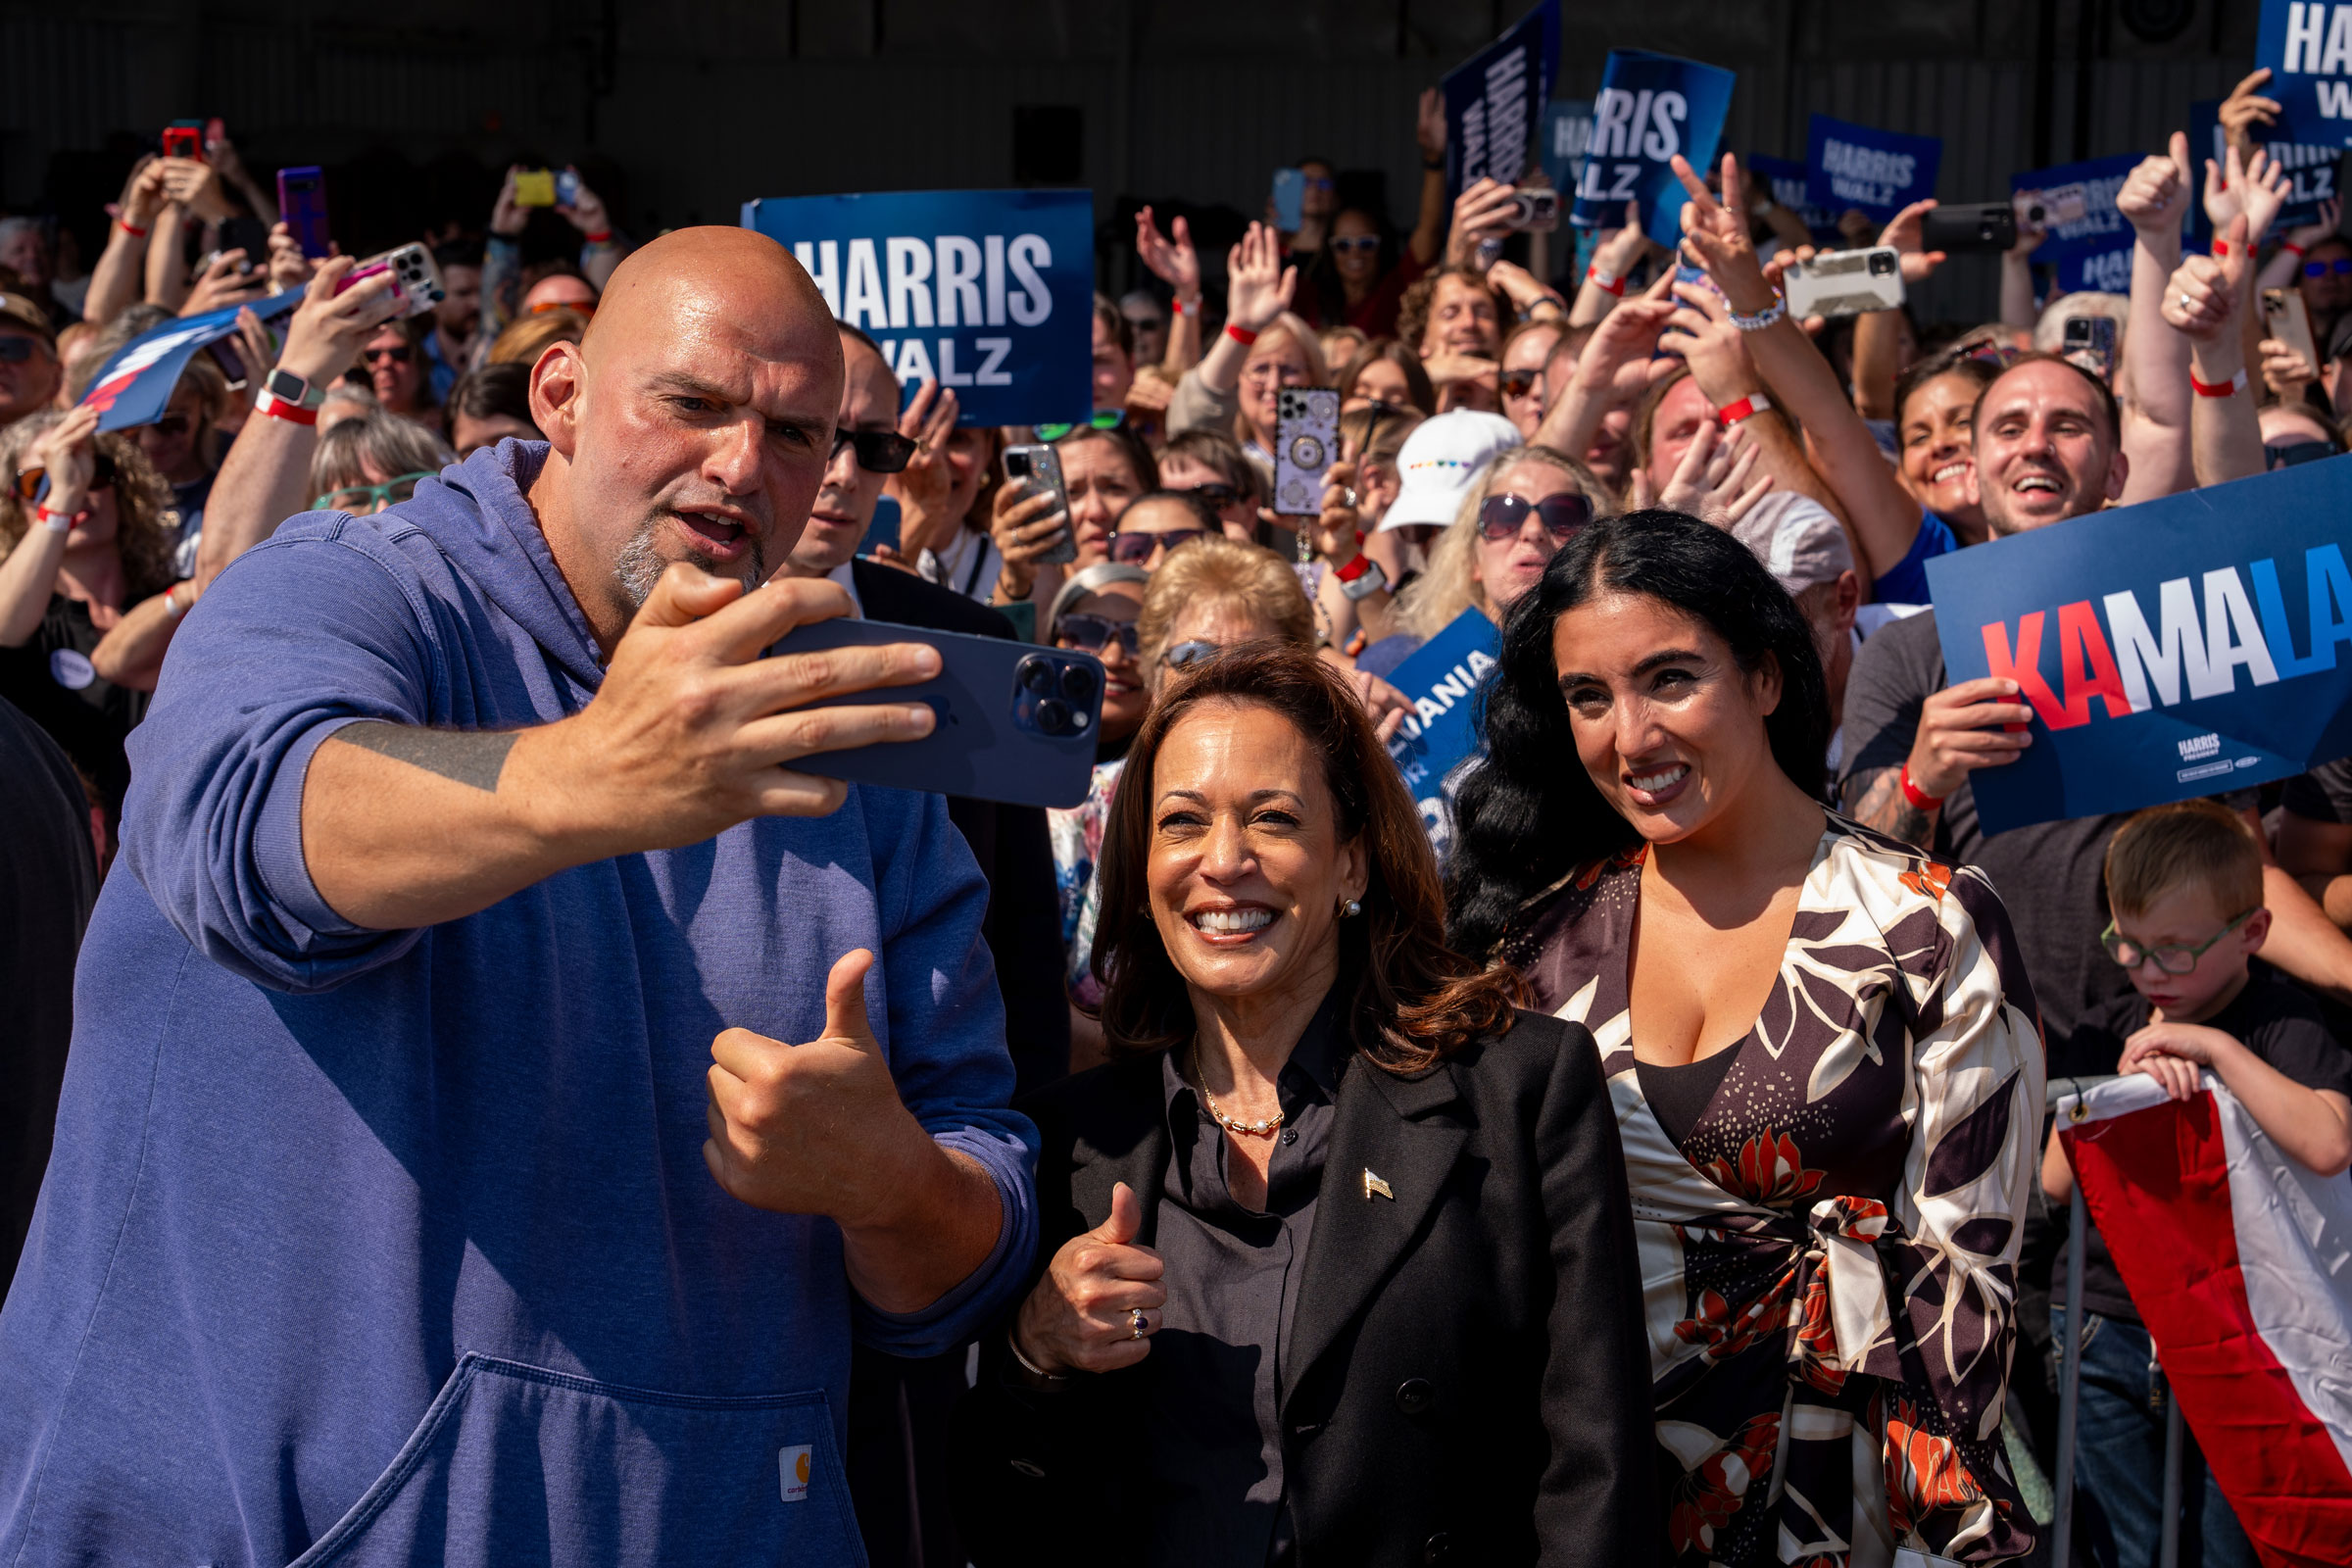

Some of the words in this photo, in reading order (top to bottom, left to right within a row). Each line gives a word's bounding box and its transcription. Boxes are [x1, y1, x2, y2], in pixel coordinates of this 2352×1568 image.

[1585, 86, 1688, 162] RIS
[1822, 137, 1916, 189] HARRIS
[1832, 176, 1894, 206] WALZ
[794, 233, 1053, 329] HARRIS
[883, 337, 1012, 386] ALZ
[1981, 543, 2352, 733] KAMALA
[2178, 732, 2221, 757] HARRIS
